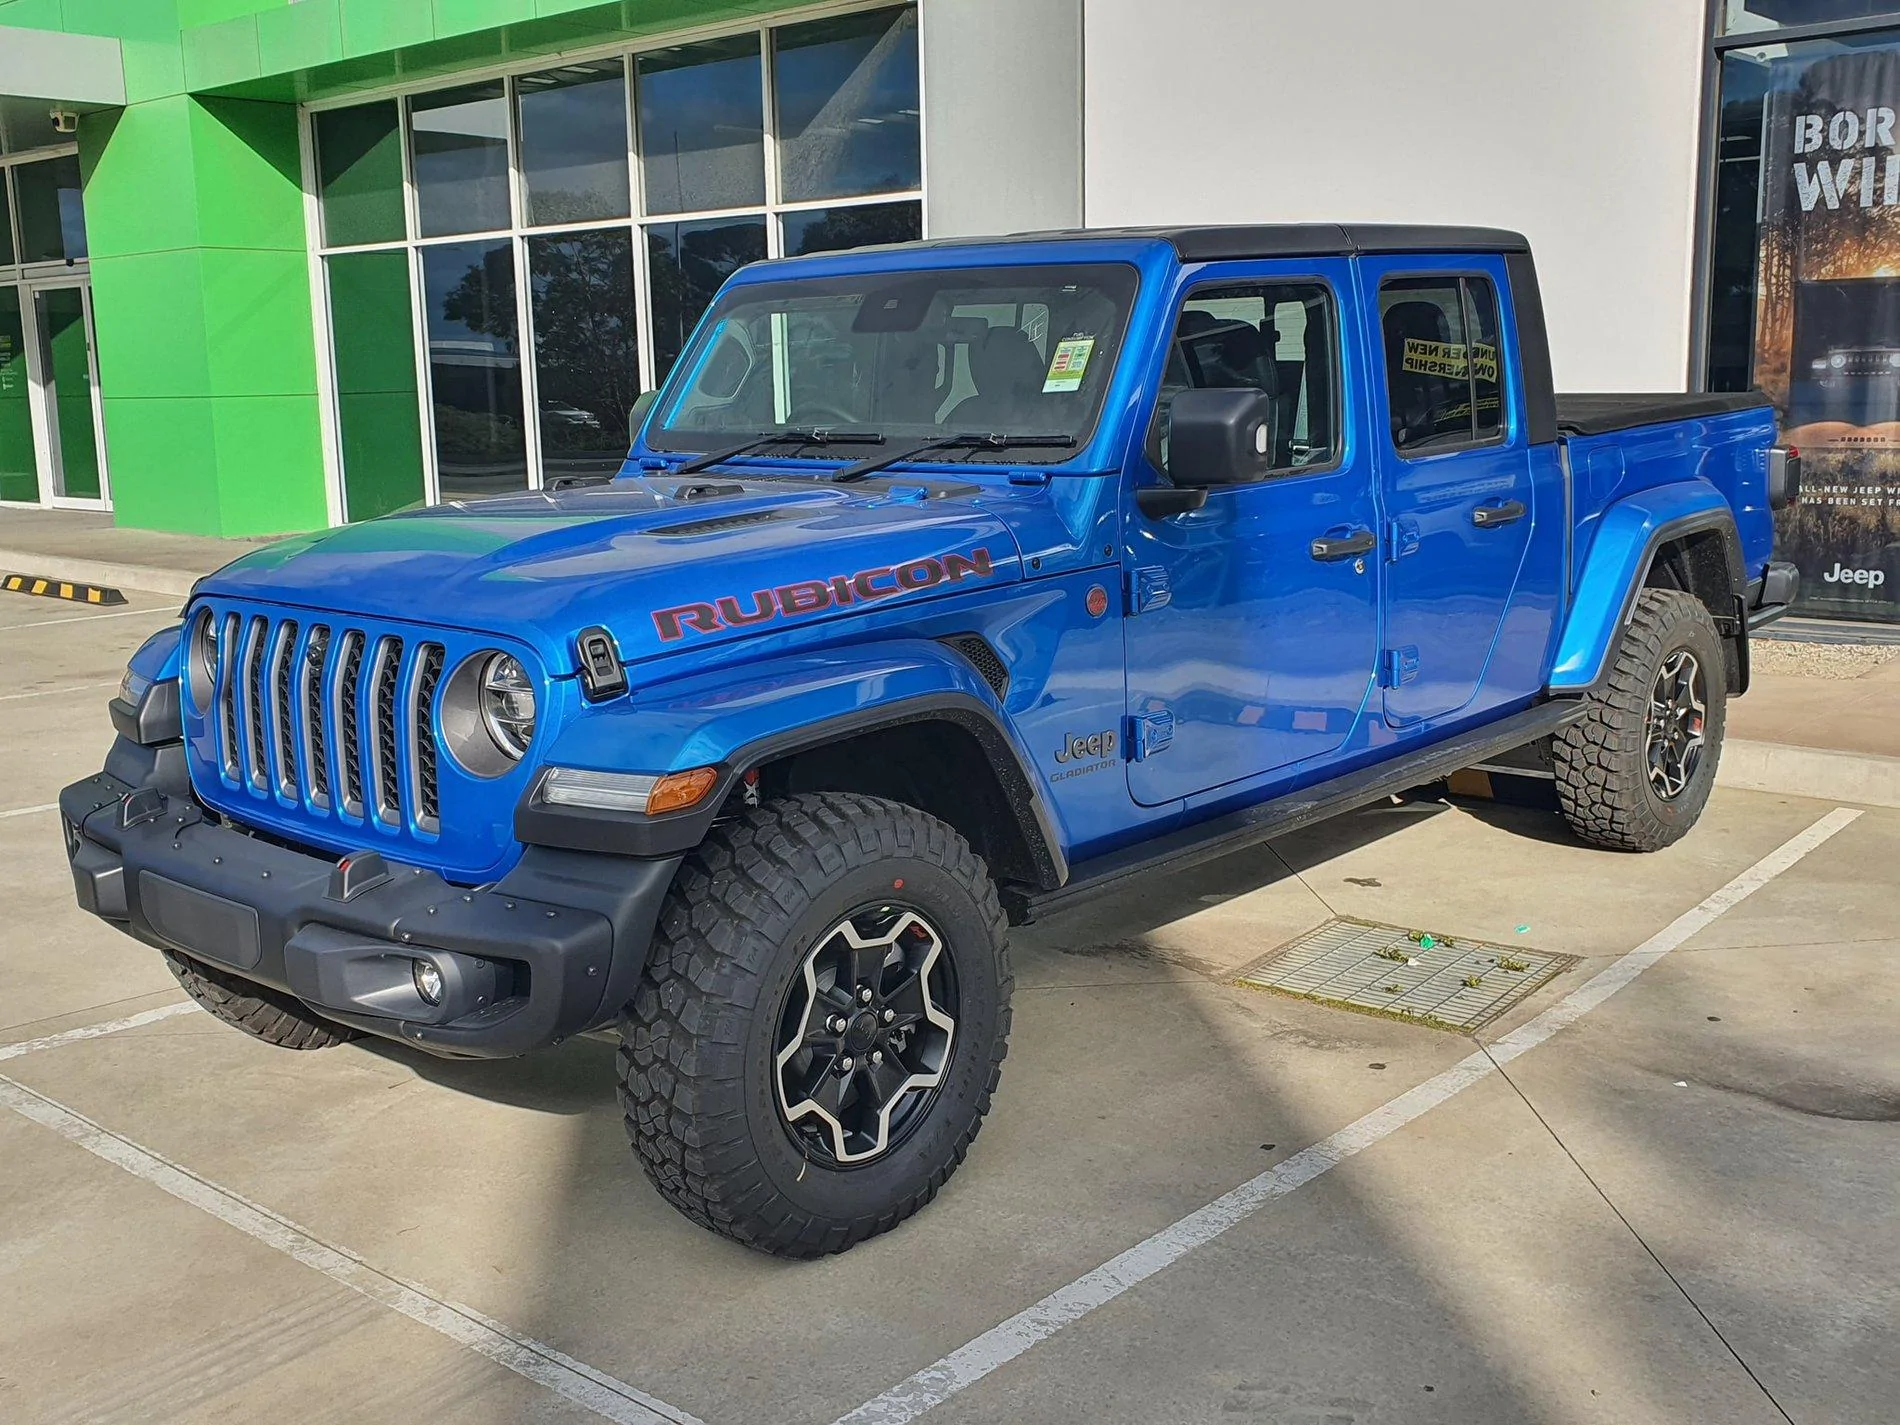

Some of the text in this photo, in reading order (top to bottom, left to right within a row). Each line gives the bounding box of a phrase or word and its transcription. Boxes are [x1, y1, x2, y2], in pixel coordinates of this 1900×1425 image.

[1794, 107, 1896, 154] BOR
[1799, 485, 1848, 494] ALL-NEW
[1853, 486, 1881, 494] JEEP
[1801, 496, 1822, 505] HAS
[1828, 497, 1856, 505] BEEN
[1861, 498, 1882, 506] SET
[1823, 562, 1885, 589] Jeep
[650, 547, 994, 643] RUBICON
[1054, 729, 1117, 764] Jeep
[1050, 758, 1117, 783] GLADIATOR
